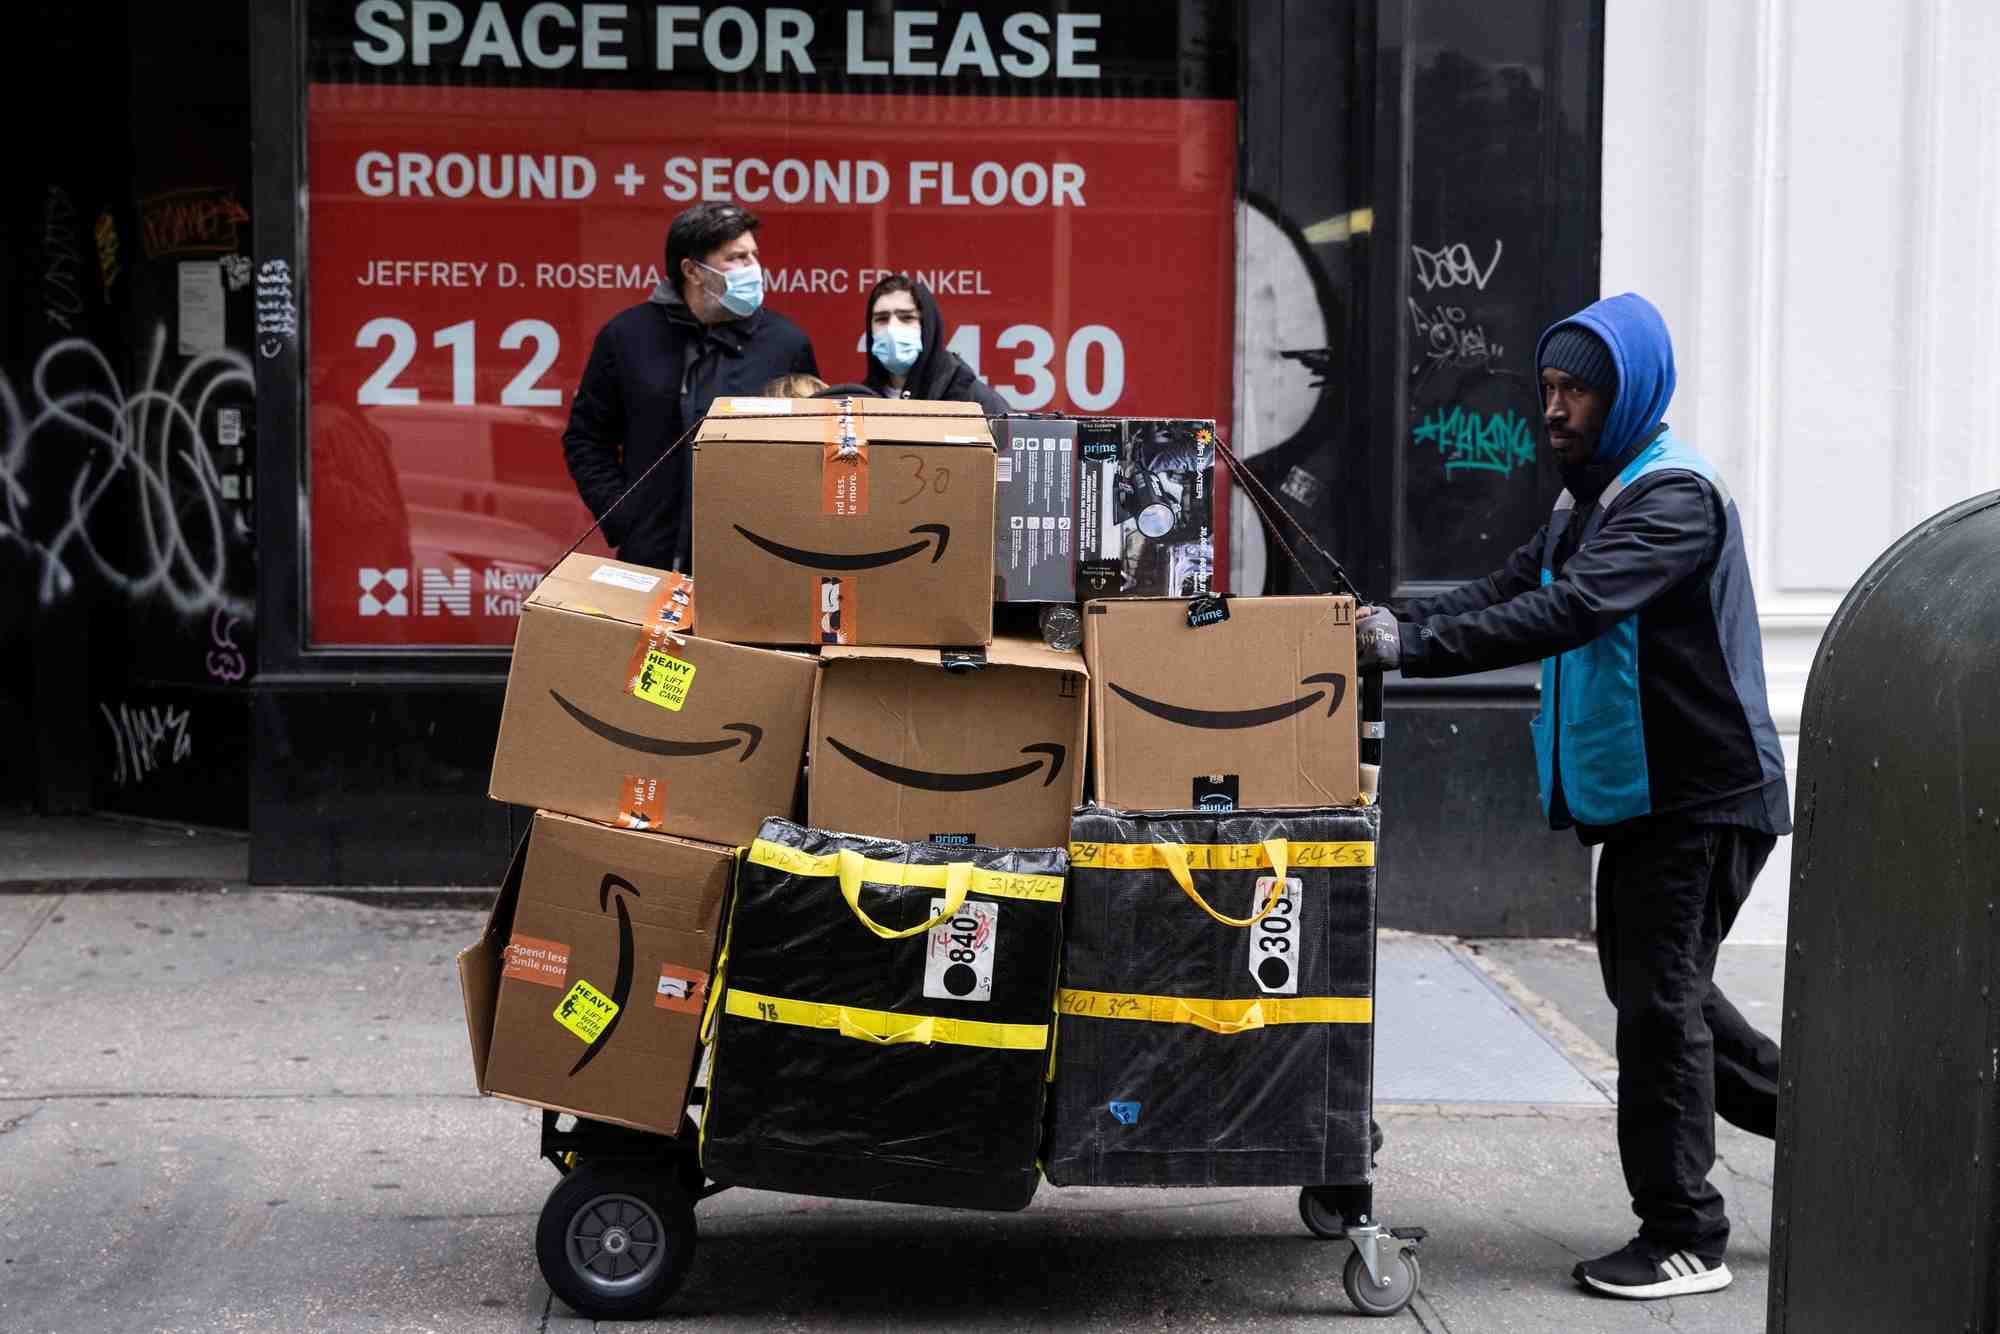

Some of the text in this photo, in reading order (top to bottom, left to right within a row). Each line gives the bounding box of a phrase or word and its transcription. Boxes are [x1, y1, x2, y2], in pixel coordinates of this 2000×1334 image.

[352, 0, 1101, 79] SPACE FOR LEASE
[355, 150, 1087, 208] GROUND + SECOND FLOOR
[357, 260, 489, 288] JEFFREY
[498, 262, 526, 289] D.
[763, 268, 849, 294] MARC
[354, 316, 563, 407] 212
[857, 323, 1125, 413] 430
[1084, 442, 1117, 456] prime
[847, 472, 857, 502] more.
[899, 453, 951, 504] 30
[484, 567, 545, 590] New
[1191, 608, 1223, 626] prime
[648, 653, 690, 675] HEAVY
[662, 681, 684, 696] WITH
[664, 674, 683, 686] LIFT
[659, 690, 681, 704] CARE
[633, 787, 645, 807] gift
[647, 779, 657, 801] now
[1200, 801, 1233, 814] prime
[934, 833, 969, 844] prime
[1258, 897, 1292, 954] 303
[512, 943, 546, 959] Spend
[949, 917, 978, 963] 840
[511, 955, 540, 970] Smile
[575, 984, 613, 1013] HEAVY
[581, 1015, 601, 1030] WITH
[585, 1008, 602, 1022] LIFT
[576, 1021, 598, 1038] CARE
